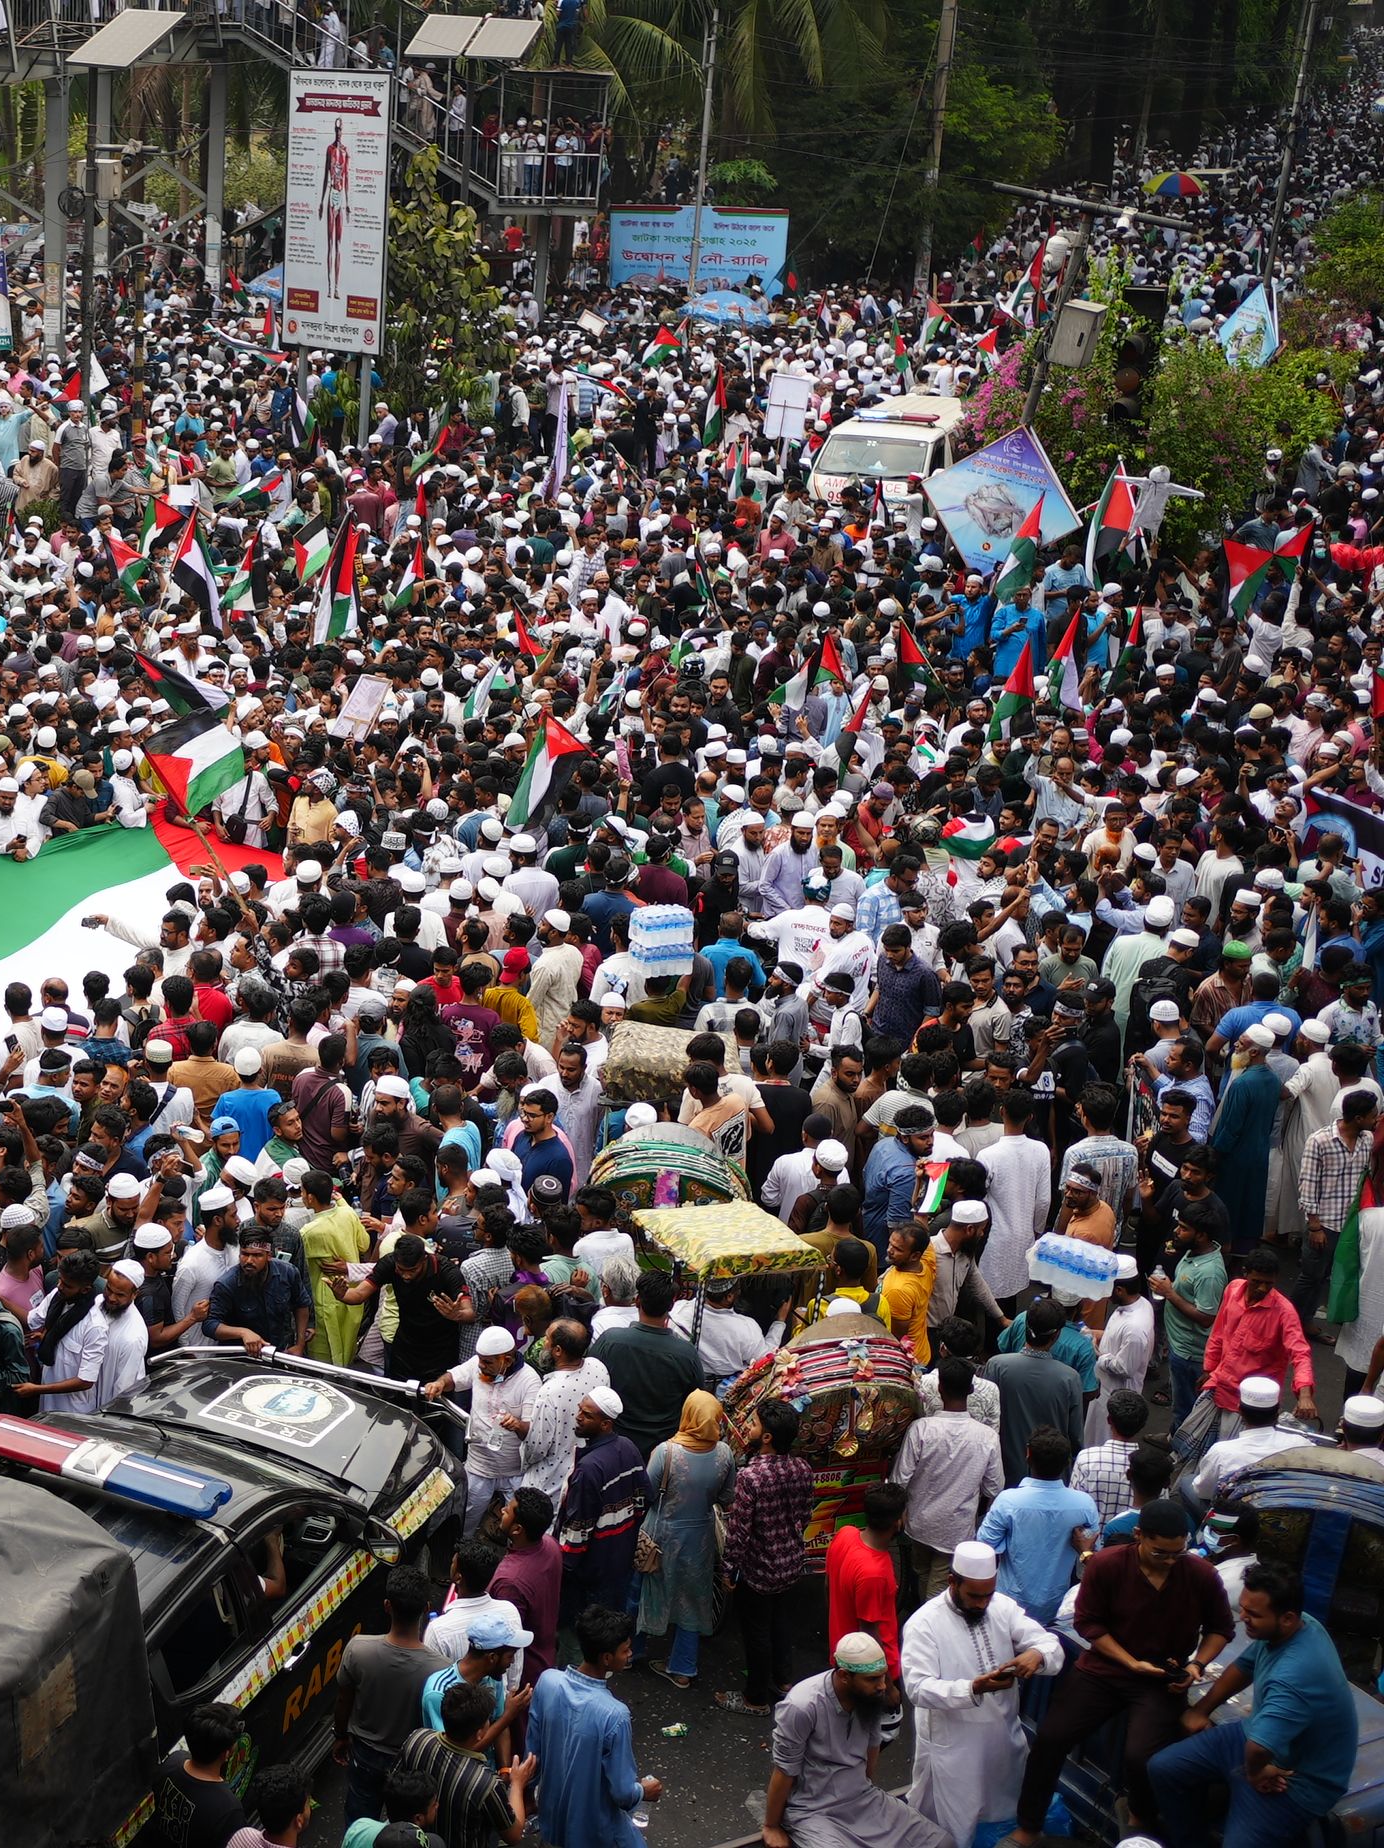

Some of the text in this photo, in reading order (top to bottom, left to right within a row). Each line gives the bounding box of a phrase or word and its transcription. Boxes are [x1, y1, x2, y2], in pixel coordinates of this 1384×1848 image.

[632, 233, 660, 243] জাটকা
[729, 238, 758, 249] ২০২৫
[622, 249, 676, 263] উদ্বোধন
[282, 1638, 344, 1736] RAB
